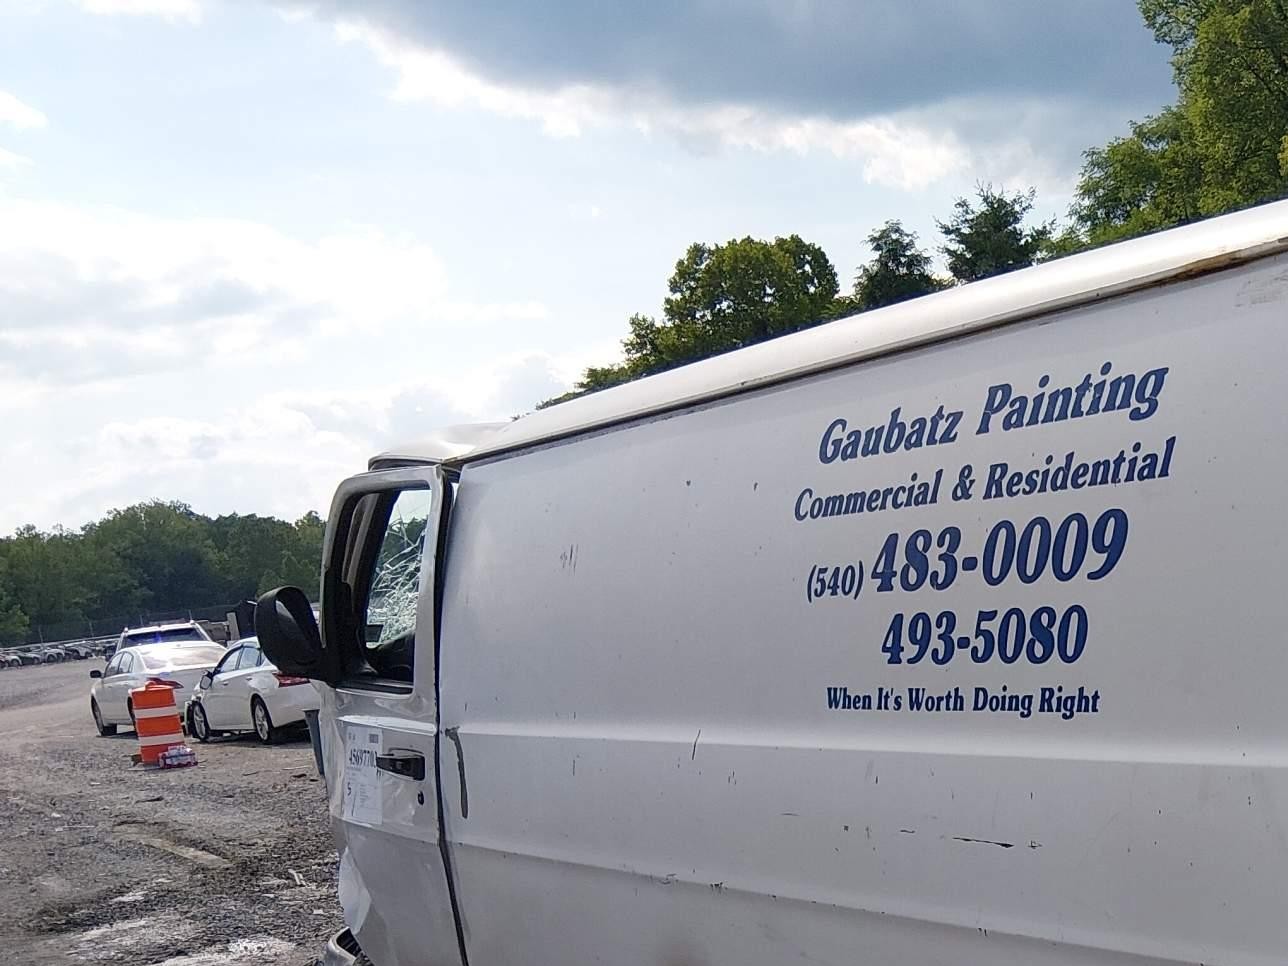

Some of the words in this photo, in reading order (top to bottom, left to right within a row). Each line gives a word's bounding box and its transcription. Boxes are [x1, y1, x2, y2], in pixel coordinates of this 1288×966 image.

[818, 404, 964, 465] Gaubatz
[975, 361, 1170, 436] Painting
[794, 468, 944, 522] Commercial
[951, 463, 976, 502] &
[982, 435, 1177, 501] Residential
[806, 559, 865, 604] (540)
[870, 508, 1129, 593] 483-0009
[881, 604, 1089, 666] 493-5080
[826, 686, 873, 712] When
[876, 686, 903, 713] It's
[907, 686, 965, 713] Worth
[972, 684, 1034, 719] Doing
[1038, 685, 1101, 721] Right
